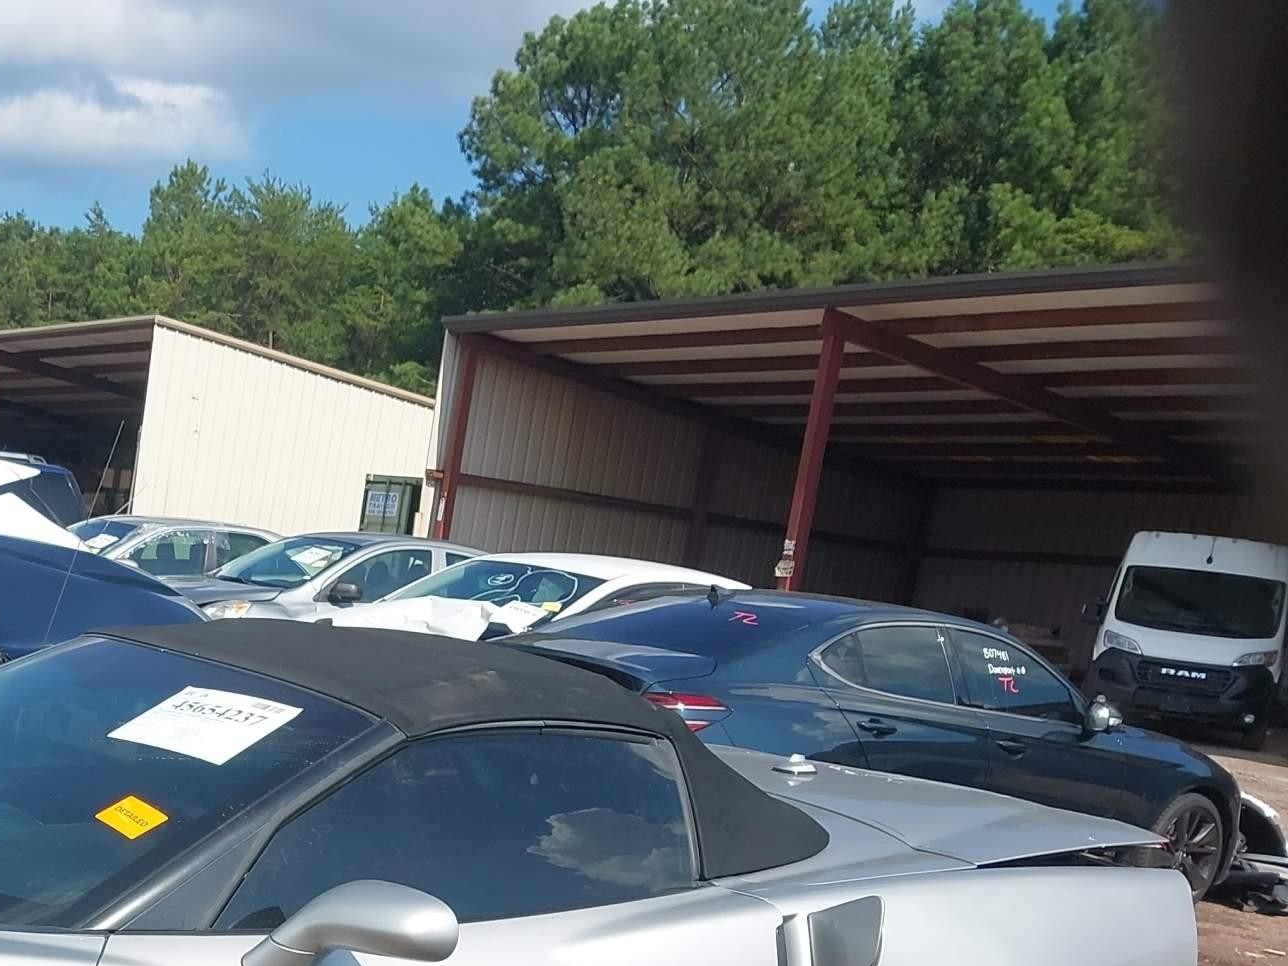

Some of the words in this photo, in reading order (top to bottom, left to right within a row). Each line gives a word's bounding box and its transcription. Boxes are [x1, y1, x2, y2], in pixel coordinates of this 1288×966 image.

[1161, 667, 1207, 680] RAM
[172, 700, 269, 726] 45654237
[114, 805, 149, 827] DETAILED
